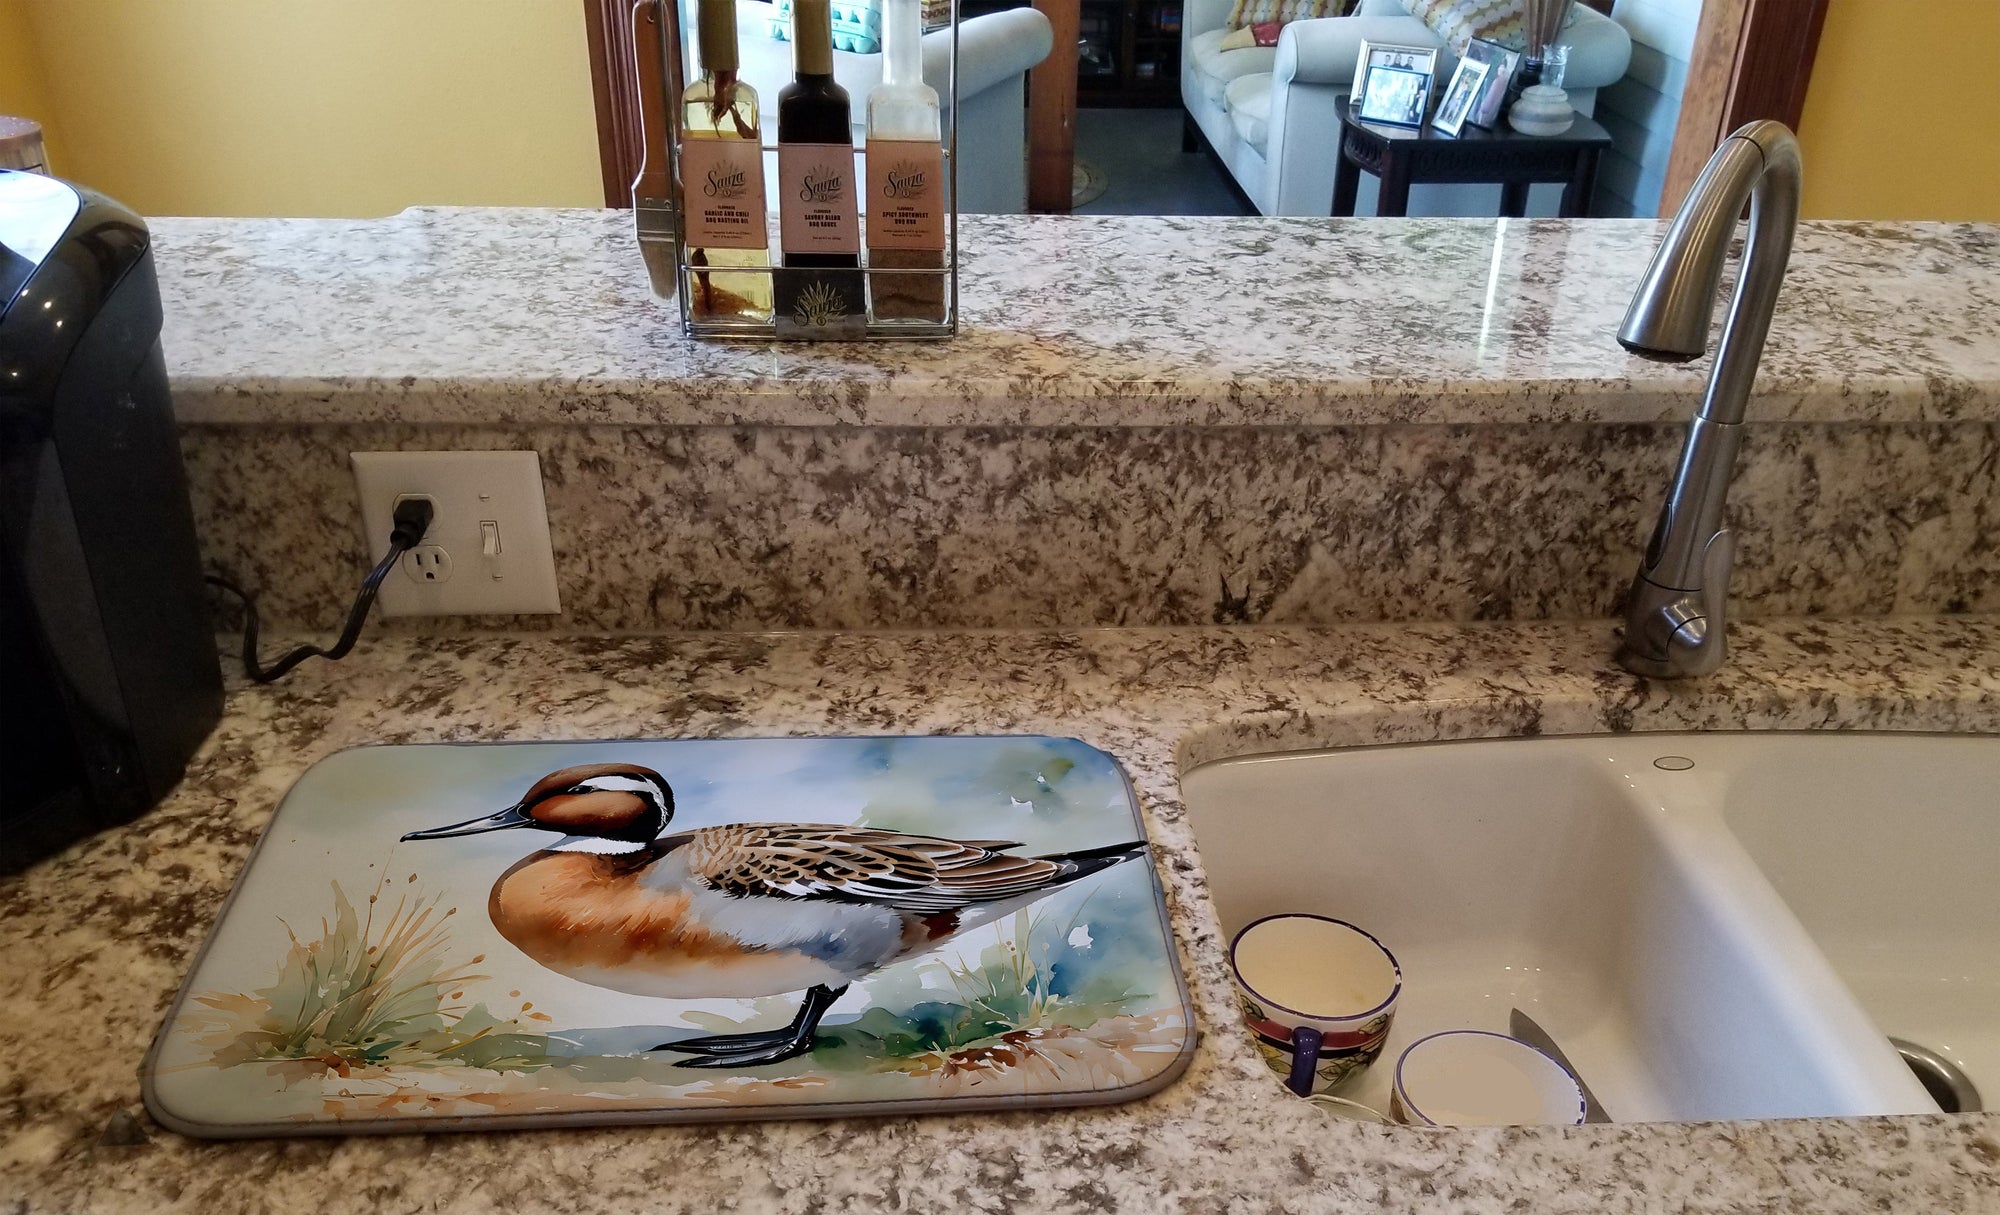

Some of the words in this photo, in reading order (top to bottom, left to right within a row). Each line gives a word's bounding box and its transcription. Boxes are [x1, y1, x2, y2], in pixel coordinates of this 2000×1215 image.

[704, 170, 745, 197] Sauza
[800, 175, 841, 202] Sauza
[884, 171, 924, 198] Sauza
[898, 211, 929, 219] SOUTHWEST
